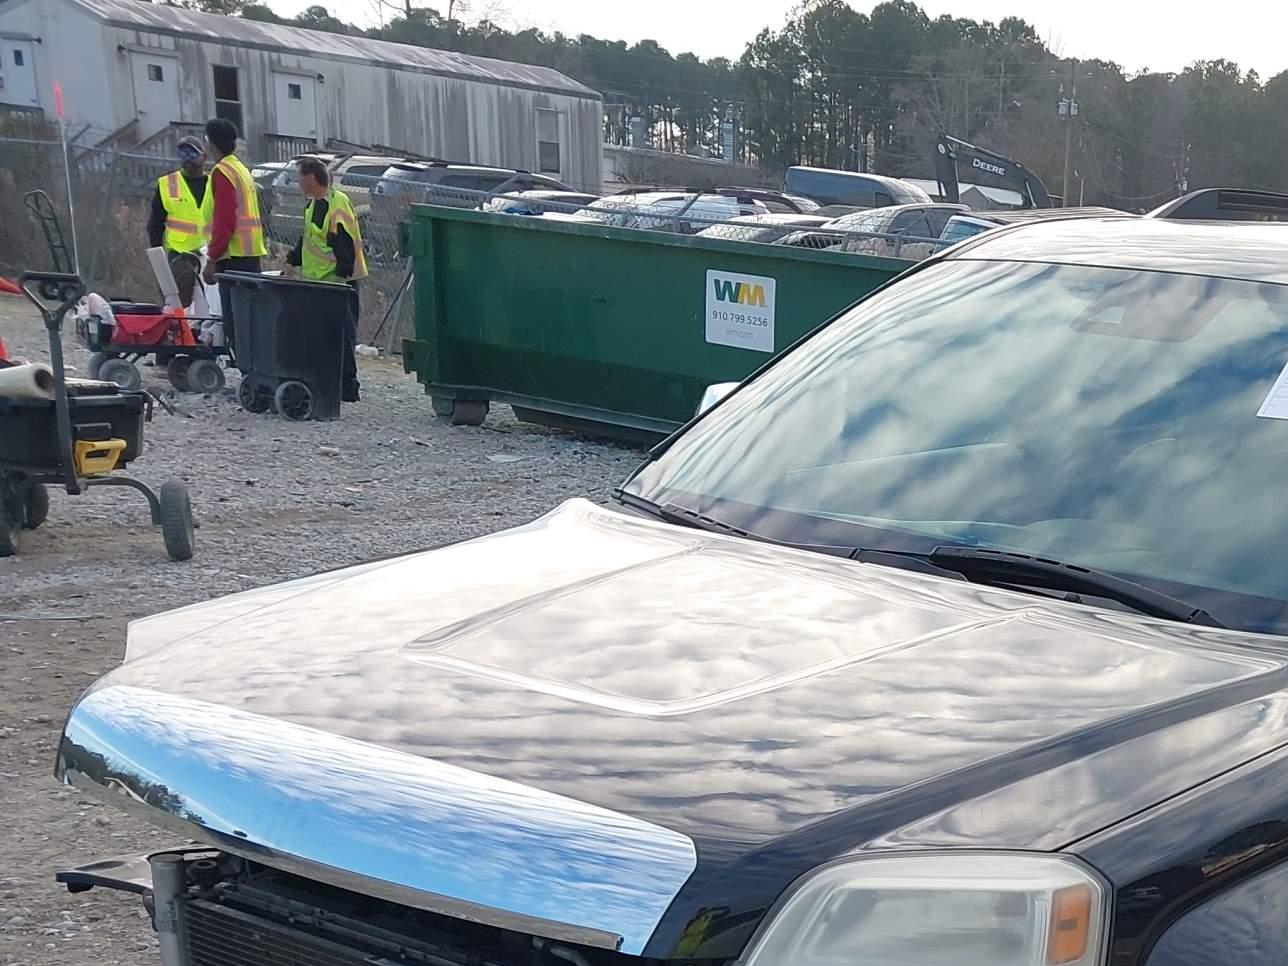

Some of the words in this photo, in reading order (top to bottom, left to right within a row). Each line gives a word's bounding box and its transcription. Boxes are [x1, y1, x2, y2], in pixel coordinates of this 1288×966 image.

[972, 158, 1006, 176] DEERE
[713, 278, 766, 308] WM
[712, 310, 728, 321] 910
[730, 312, 745, 324] 799
[747, 315, 768, 327] 5256
